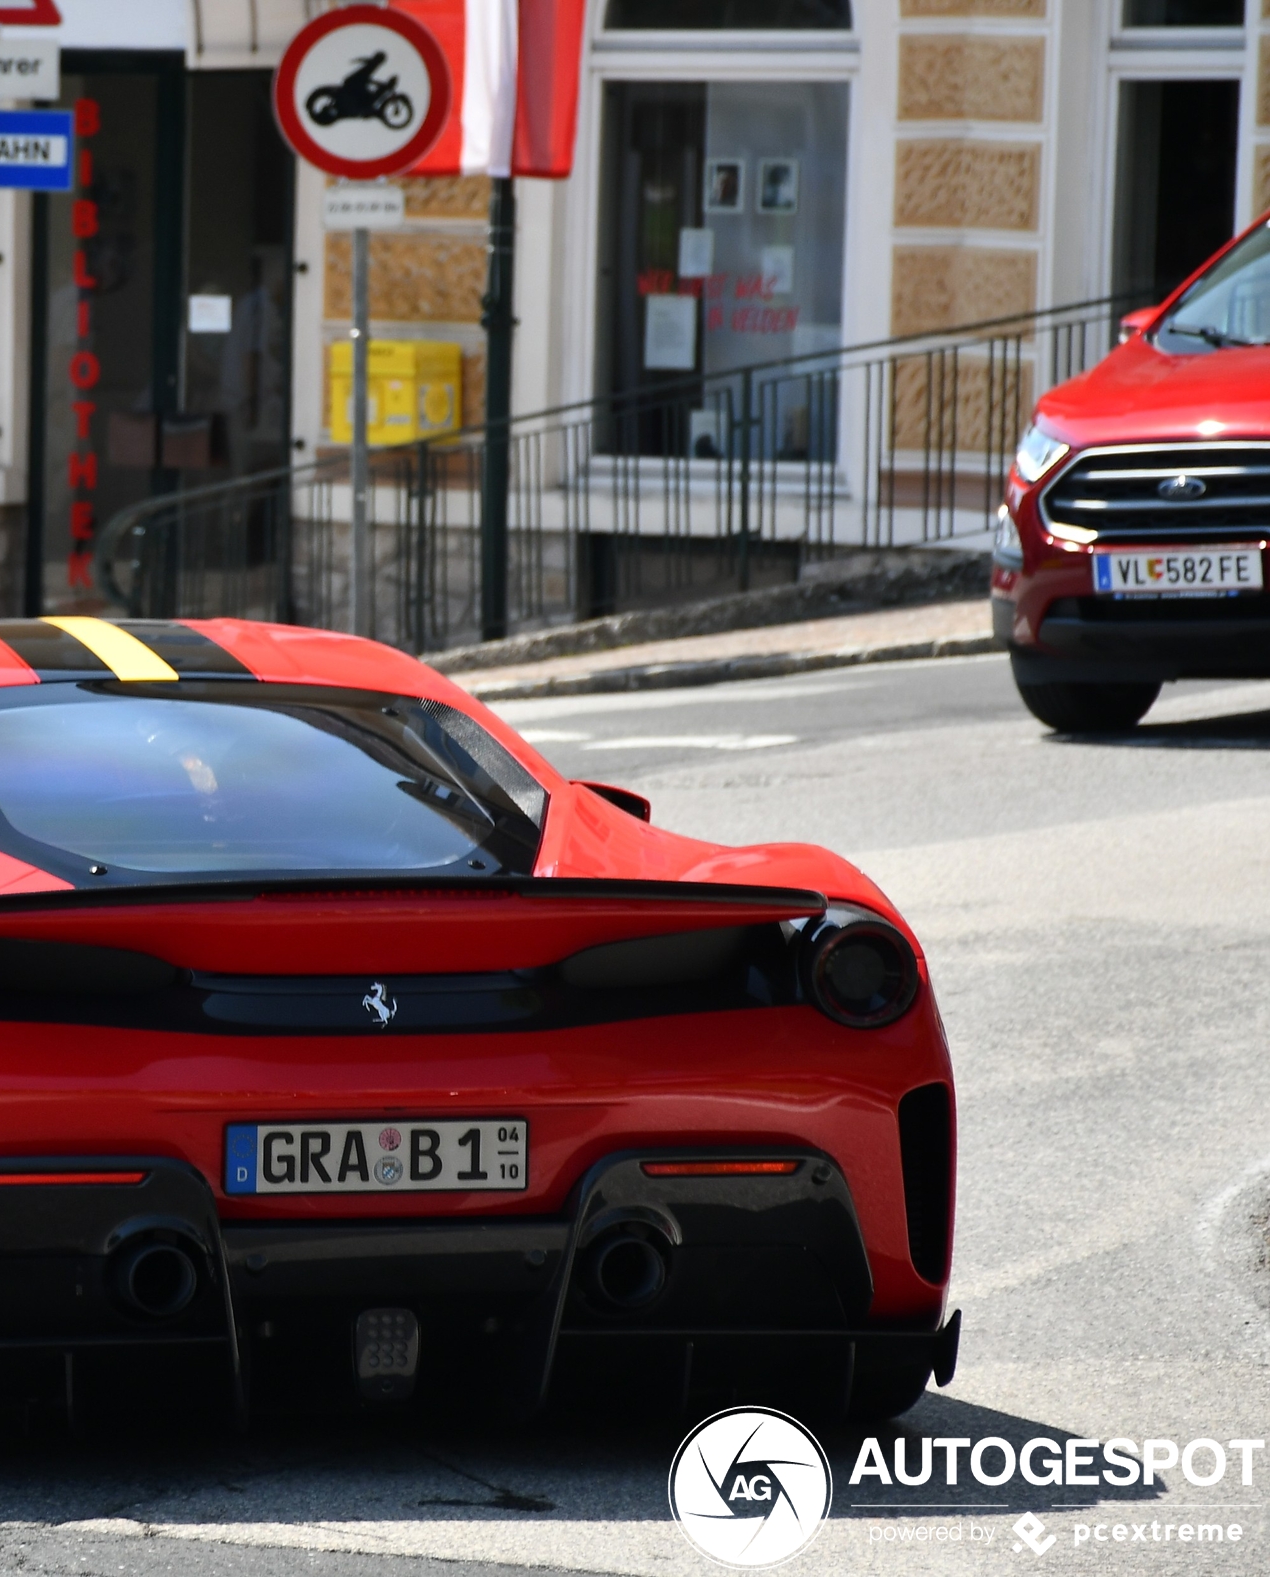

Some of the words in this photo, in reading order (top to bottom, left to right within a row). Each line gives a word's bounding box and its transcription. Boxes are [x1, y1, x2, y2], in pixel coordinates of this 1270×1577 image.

[732, 306, 799, 333] VELDEN
[68, 98, 101, 588] BIBLIOTHEK
[1118, 559, 1146, 585] VL
[1167, 557, 1212, 583] 582
[1219, 555, 1249, 581] FE
[498, 1127, 519, 1143] 04
[262, 1130, 370, 1184] GRA
[409, 1128, 443, 1181] B
[457, 1128, 488, 1180] 1
[237, 1167, 247, 1182] D
[499, 1164, 519, 1179] 10
